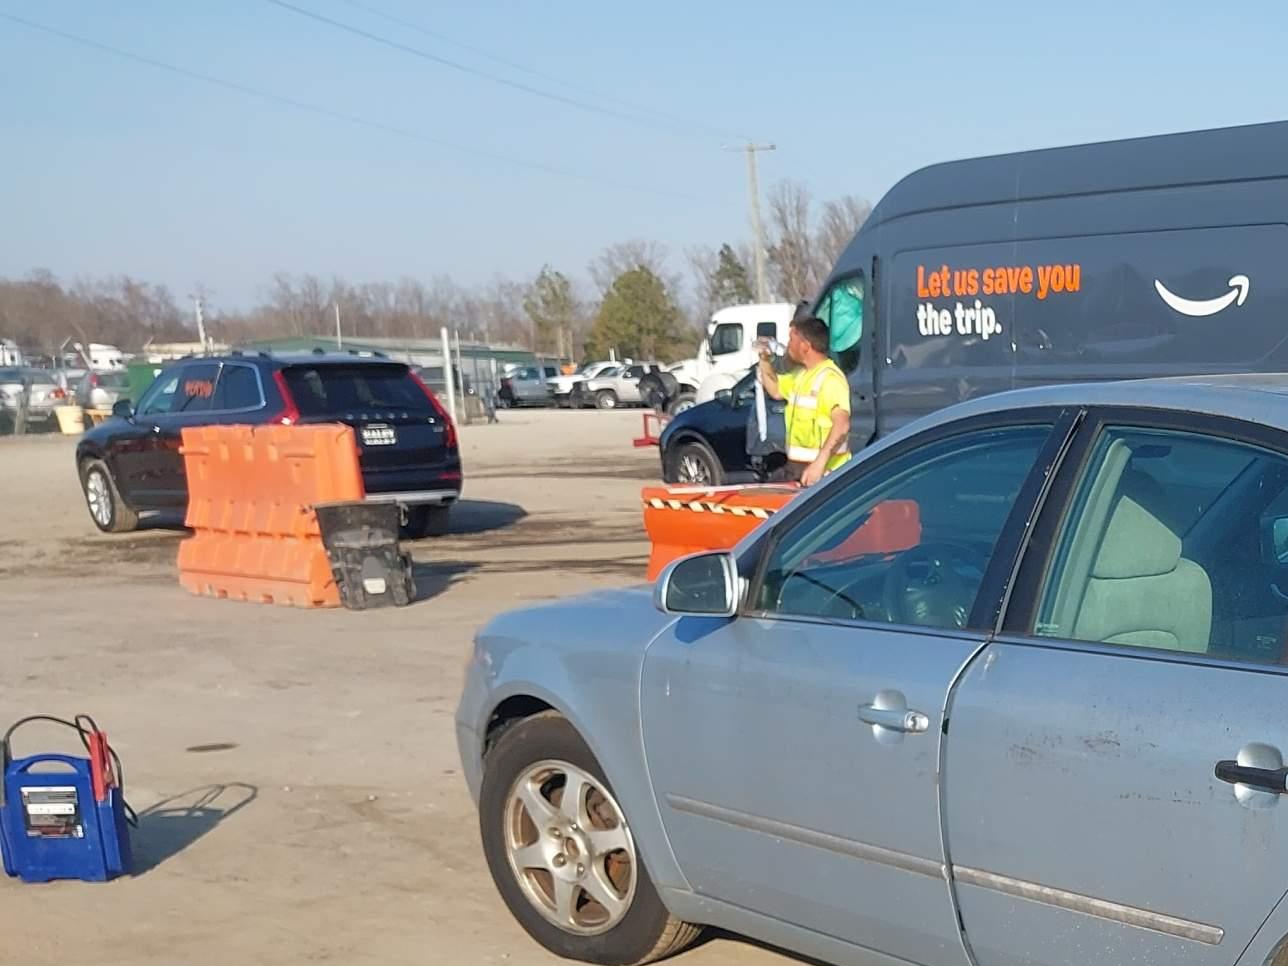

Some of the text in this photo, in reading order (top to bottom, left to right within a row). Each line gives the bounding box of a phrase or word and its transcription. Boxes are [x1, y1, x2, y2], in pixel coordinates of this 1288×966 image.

[917, 263, 1081, 300] Let us save you
[916, 299, 1003, 340] the trip.
